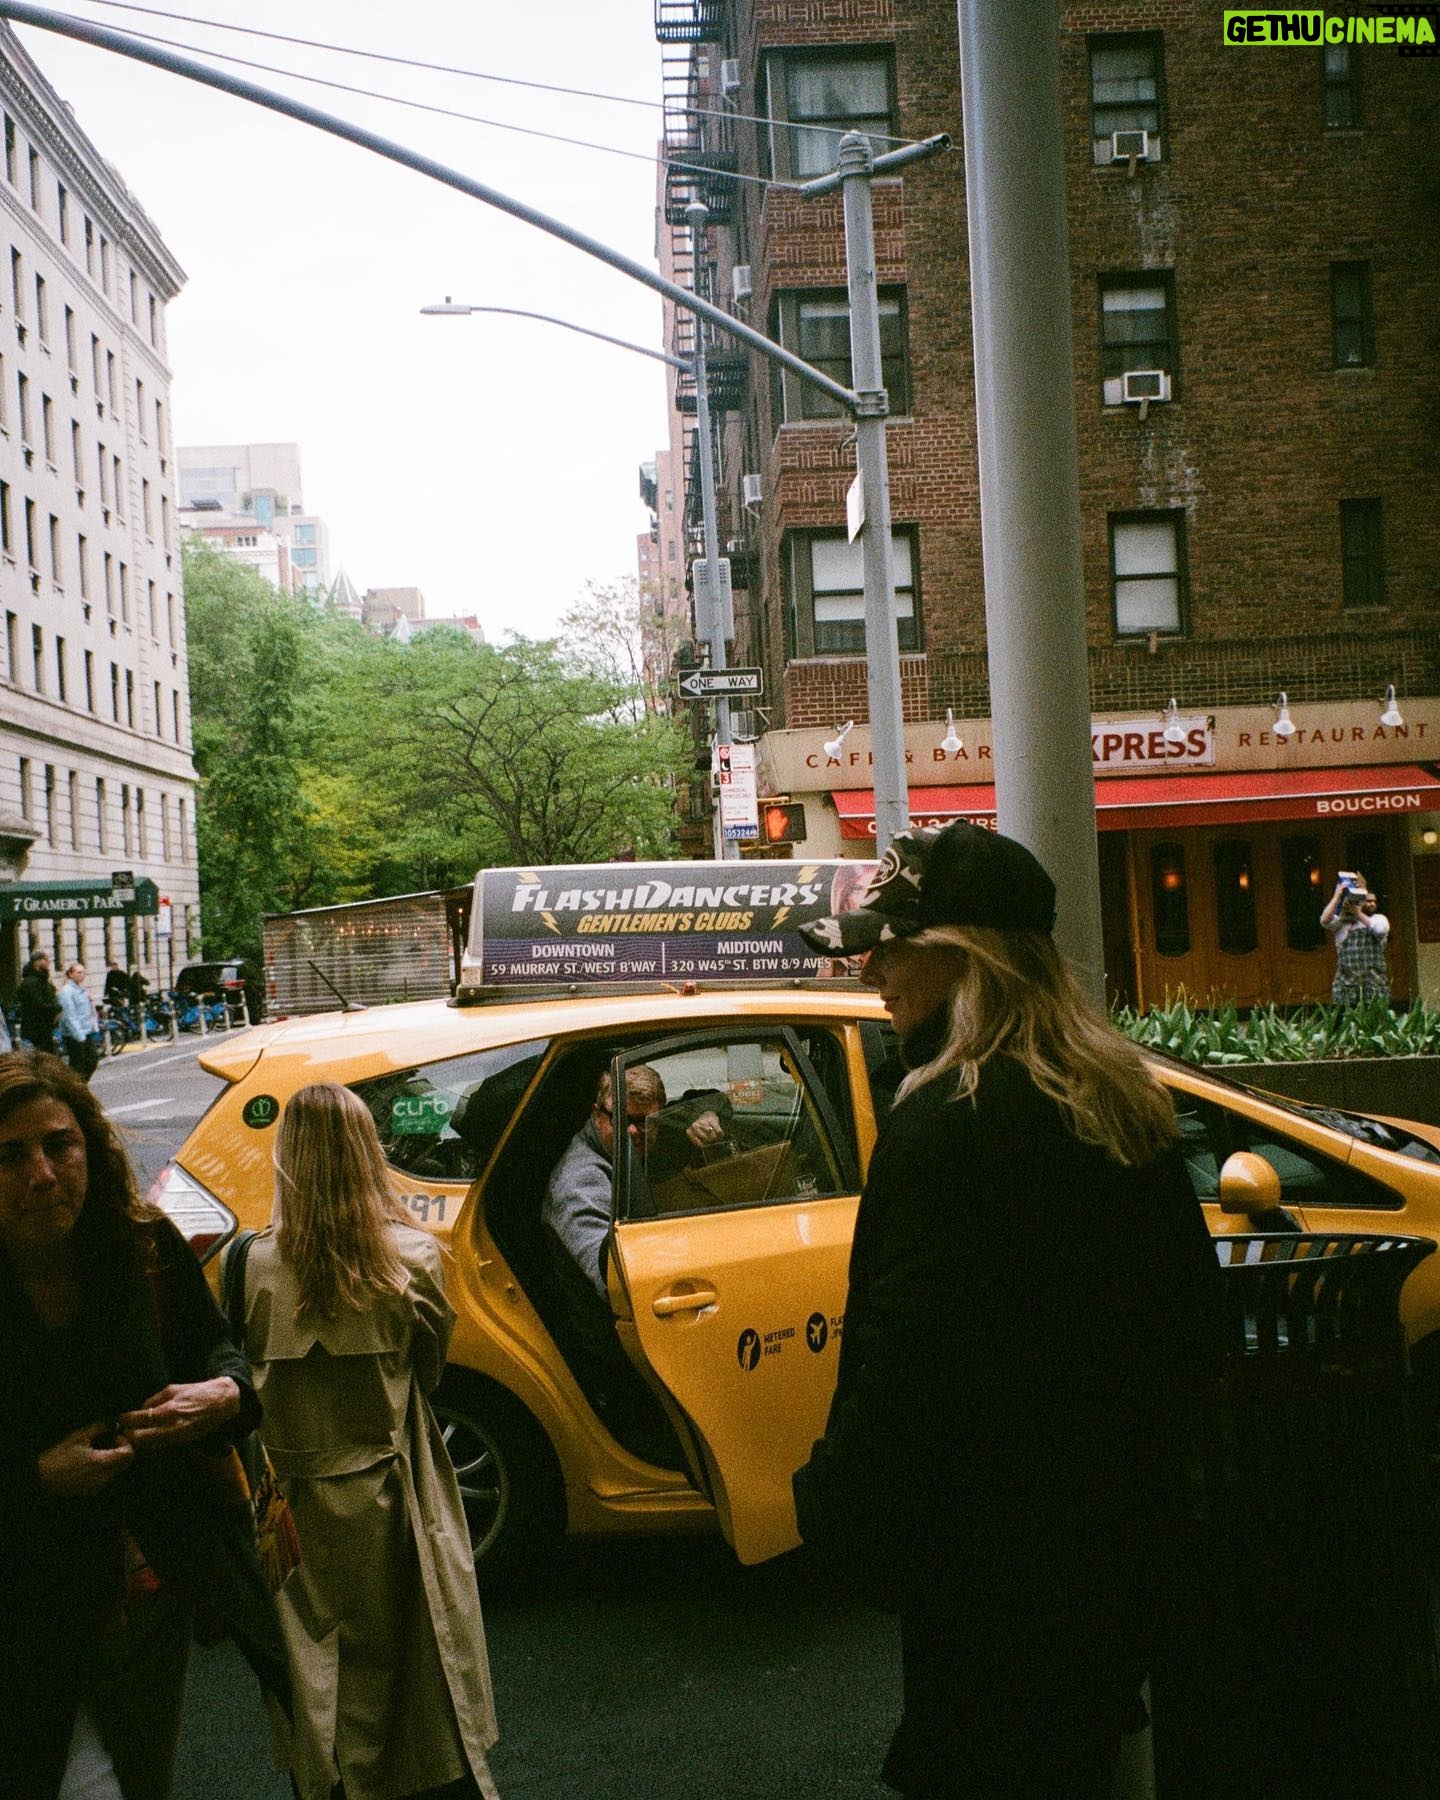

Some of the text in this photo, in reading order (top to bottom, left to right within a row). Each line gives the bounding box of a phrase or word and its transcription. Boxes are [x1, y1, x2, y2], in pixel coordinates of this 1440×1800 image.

[690, 676, 754, 688] ONE WAY
[1238, 723, 1428, 747] RESTAURANT
[806, 752, 873, 768] CAF
[933, 745, 991, 762] BAR
[724, 773, 730, 784] 3
[1317, 794, 1420, 813] BOUCHON
[14, 899, 22, 911] 7
[24, 898, 90, 911] GRAMERCY
[93, 895, 124, 908] PARK
[512, 881, 822, 912] FLASHDANCERS
[577, 911, 754, 934] GENTLEMEN'S CLUBS
[532, 944, 615, 958] DOWNTOWN
[717, 941, 783, 954] MIDTOWN
[491, 964, 506, 976] 59
[510, 962, 560, 975] MURRAY
[620, 960, 657, 973] B'WAY
[671, 960, 695, 972] 320
[733, 959, 749, 971] ST.
[753, 958, 778, 970] BTW
[781, 958, 800, 970] 8/9
[803, 957, 833, 969] AVES
[393, 1098, 449, 1116] curb
[764, 1327, 796, 1343] METERED
[765, 1343, 782, 1356] FARE
